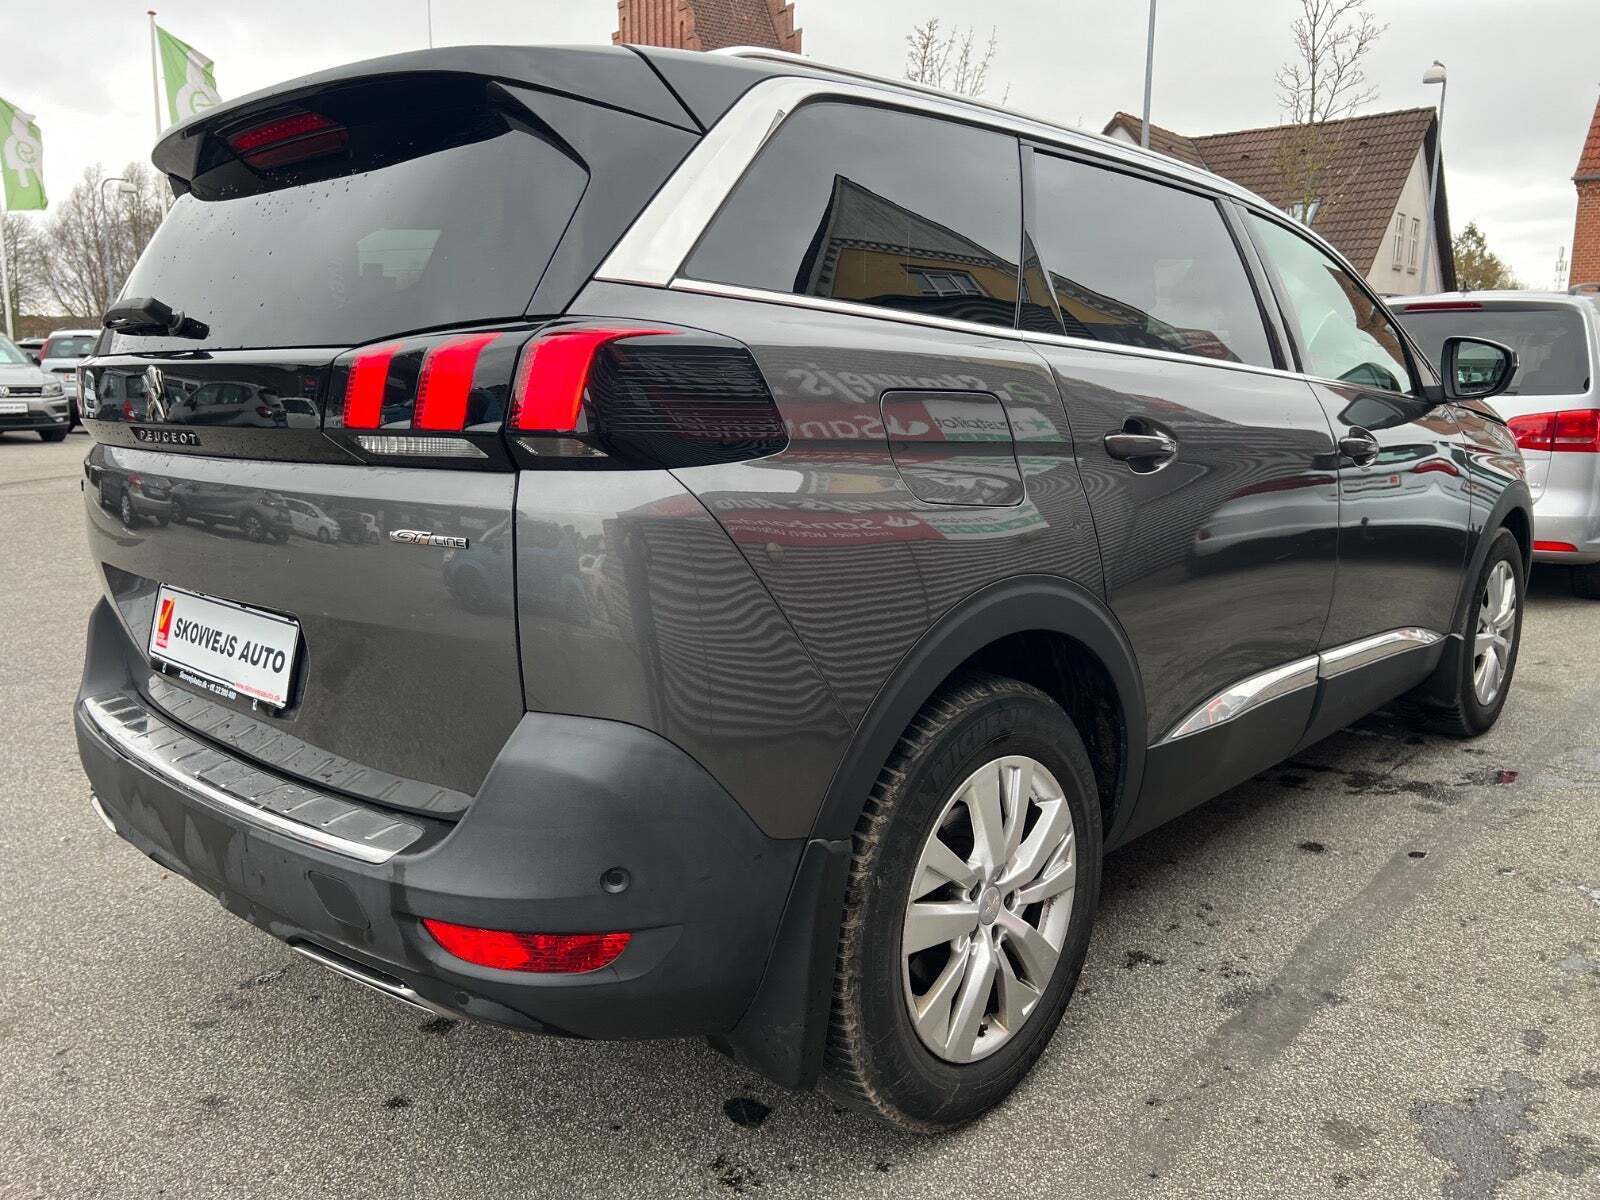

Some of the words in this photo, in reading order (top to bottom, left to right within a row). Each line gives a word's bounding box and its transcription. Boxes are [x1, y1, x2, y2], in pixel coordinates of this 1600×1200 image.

[140, 430, 196, 445] PEUGEOT
[174, 617, 238, 658] SKOVVEJS
[238, 640, 286, 674] AUTO
